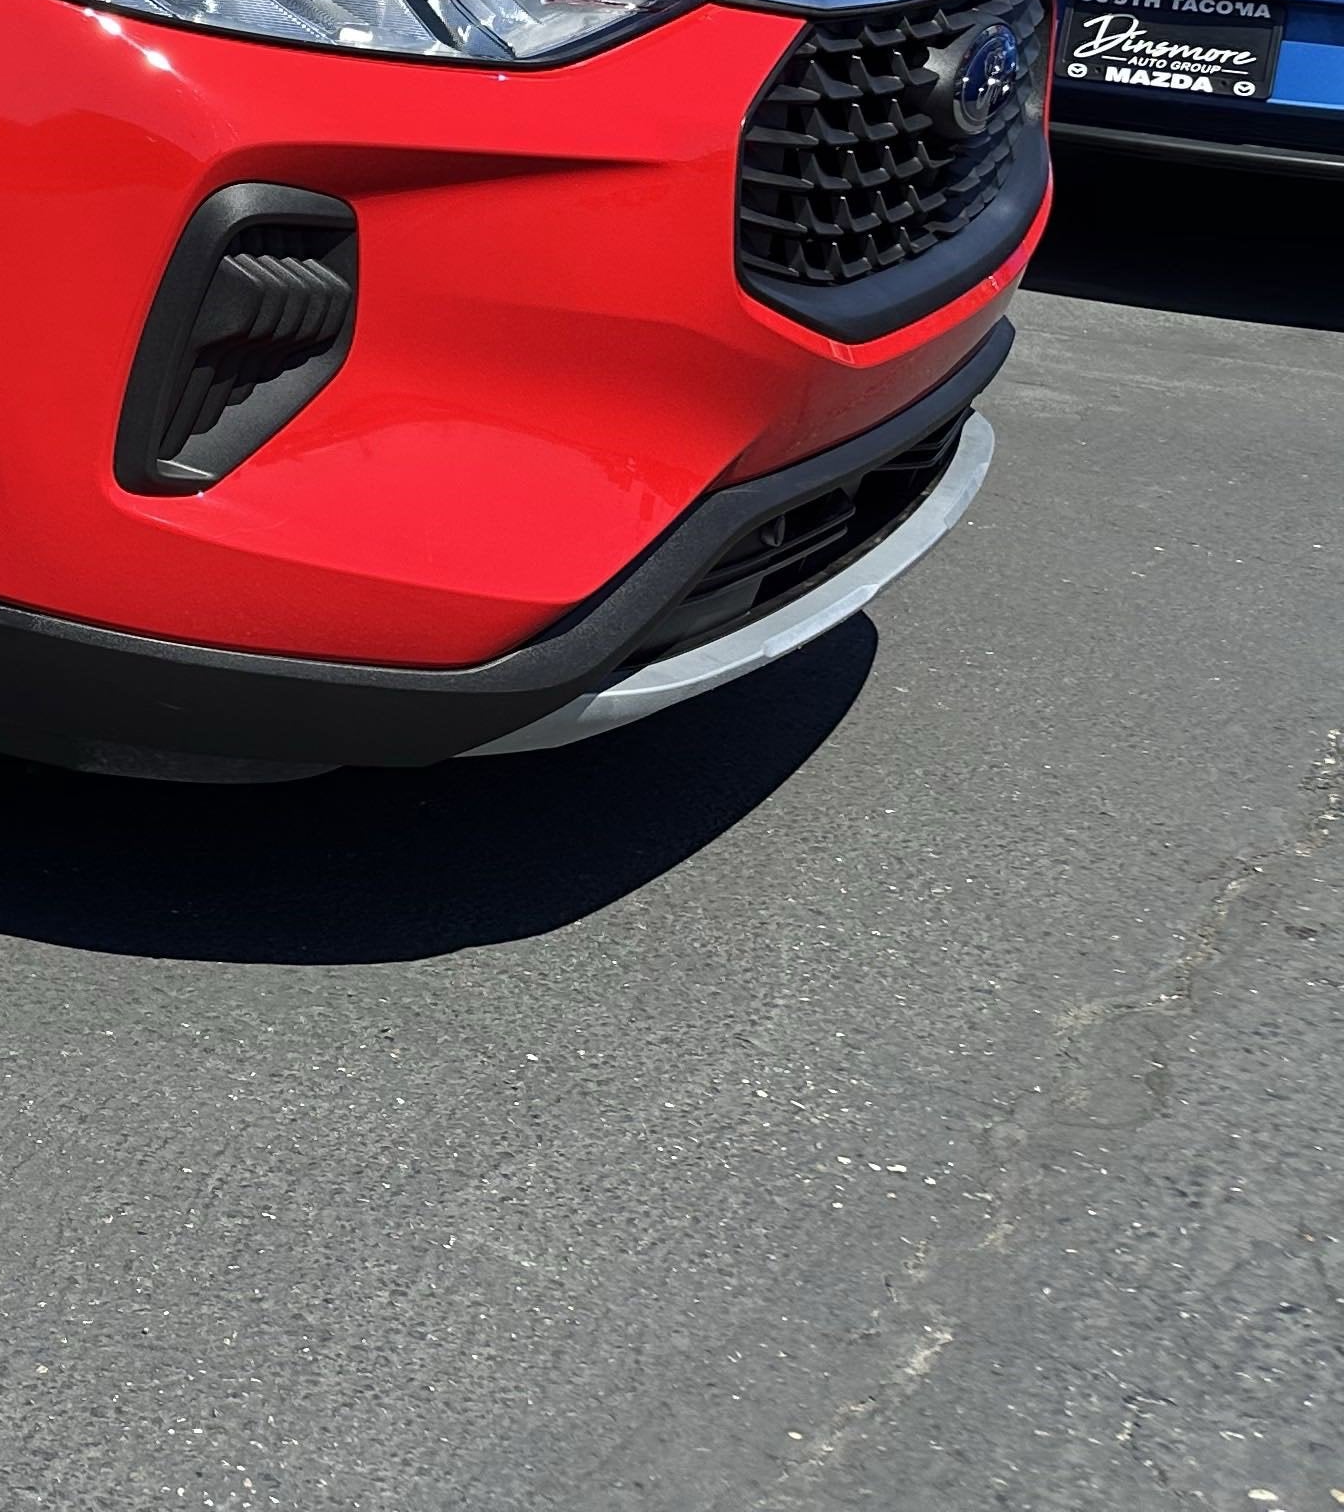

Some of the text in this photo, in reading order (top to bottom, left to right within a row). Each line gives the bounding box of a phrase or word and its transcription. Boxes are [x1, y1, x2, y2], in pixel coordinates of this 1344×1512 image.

[1073, 13, 1257, 66] Dinsmore
[1128, 56, 1222, 74] AUTO GROUP
[1105, 66, 1214, 93] MAZDA
